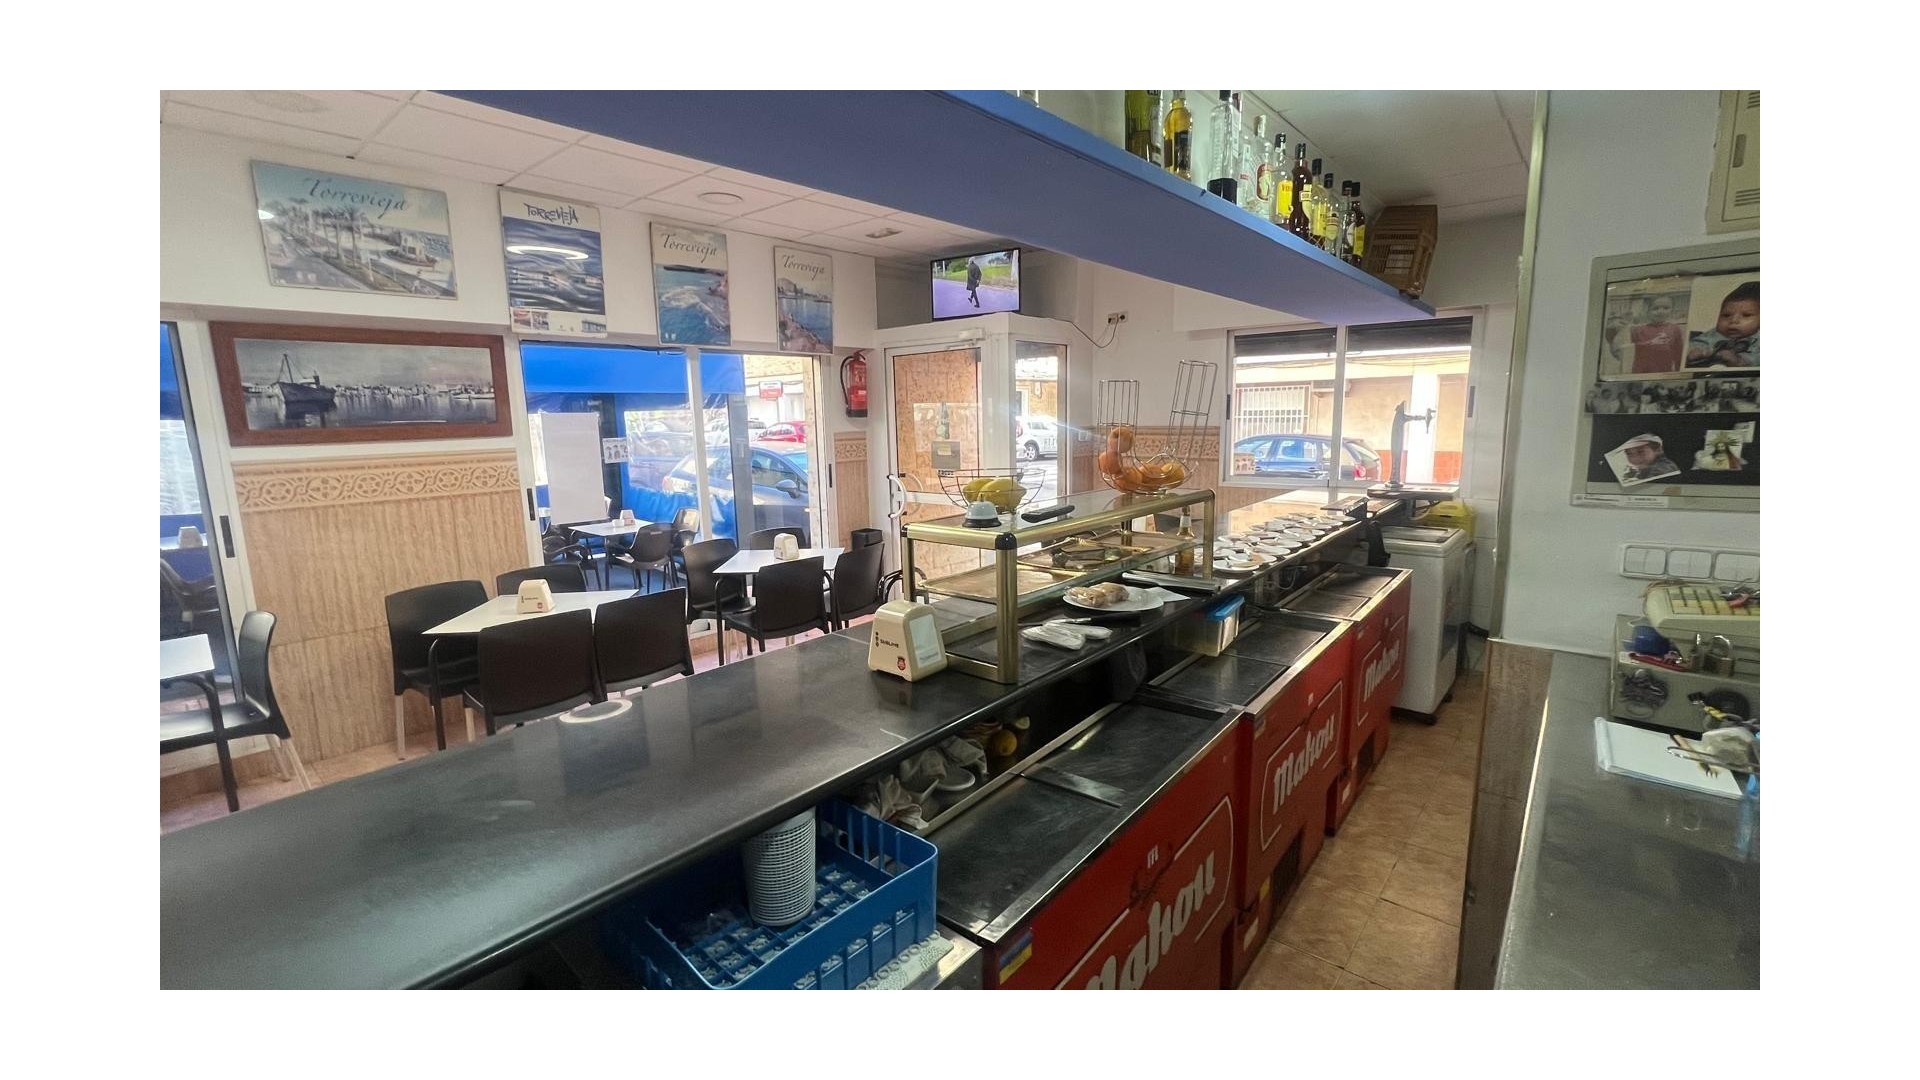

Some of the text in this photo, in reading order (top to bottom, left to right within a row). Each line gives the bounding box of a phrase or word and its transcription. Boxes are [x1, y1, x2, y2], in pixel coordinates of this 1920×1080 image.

[305, 177, 406, 219] Torrevieja
[523, 202, 578, 225] TORREVIEJA
[661, 232, 717, 263] Torrevieja
[782, 254, 825, 280] Torrevieja
[1273, 713, 1335, 815] Mahou
